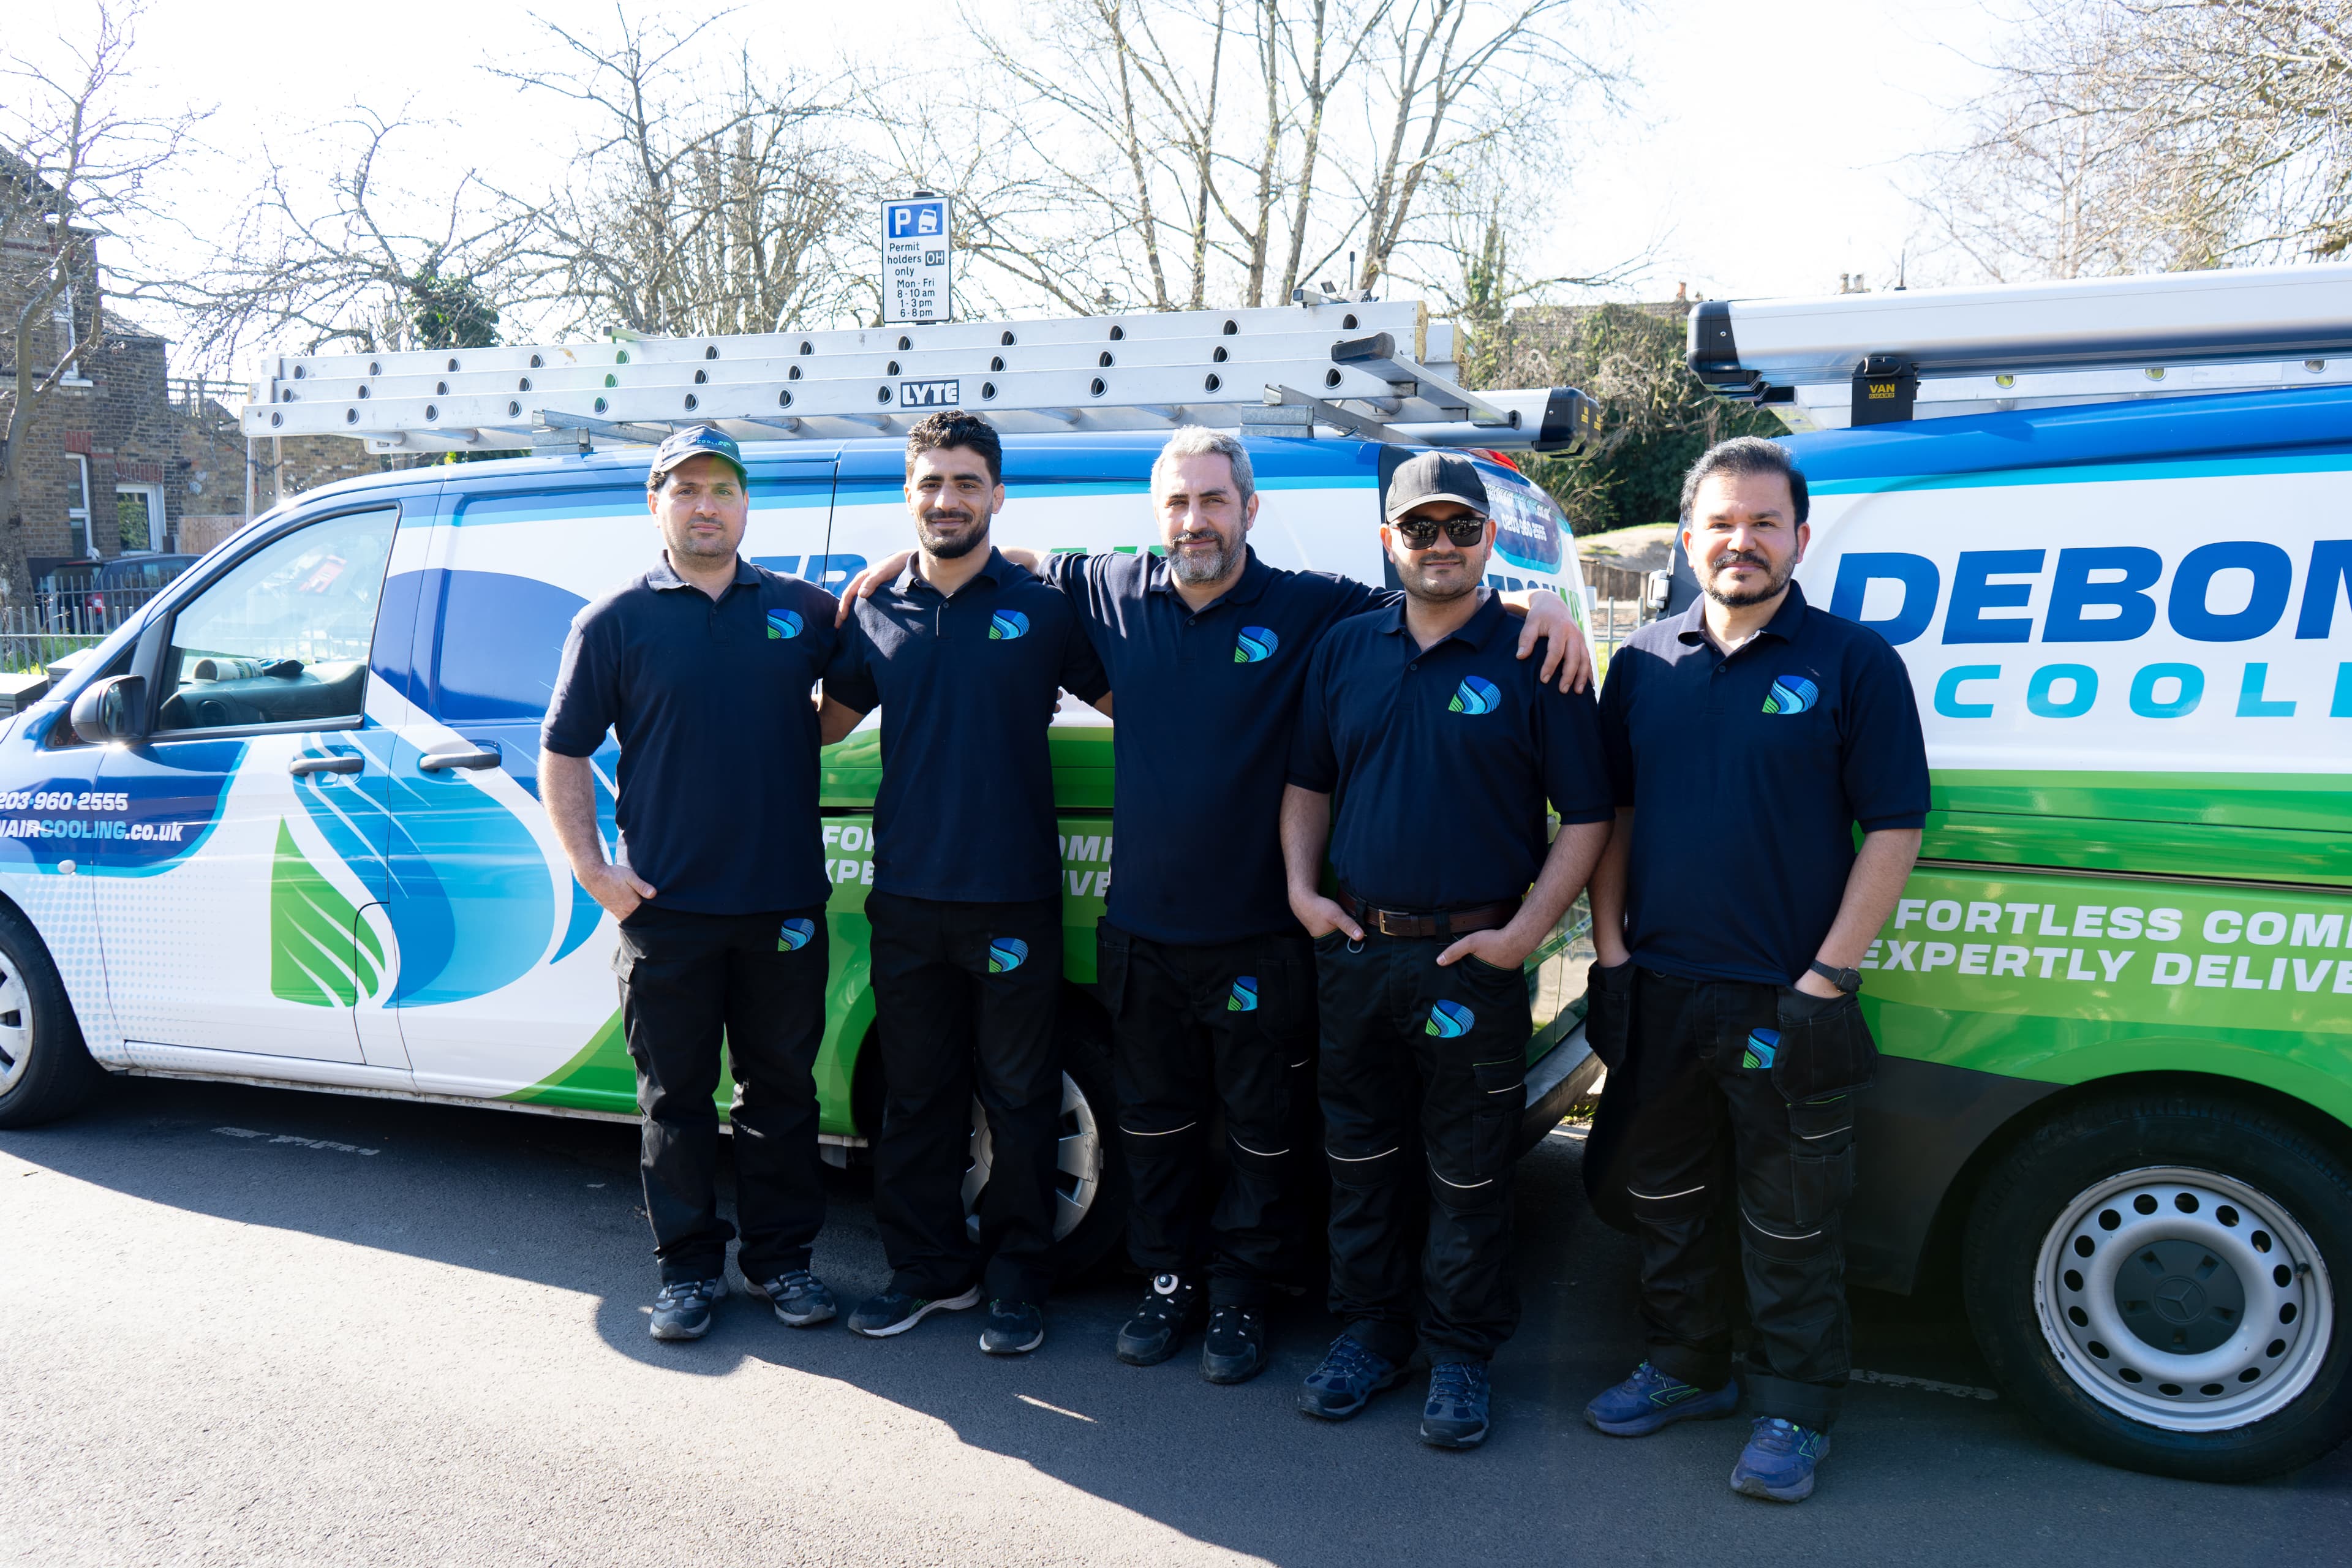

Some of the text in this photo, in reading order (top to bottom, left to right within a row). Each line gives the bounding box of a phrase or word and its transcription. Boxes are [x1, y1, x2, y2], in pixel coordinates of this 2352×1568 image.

[895, 208, 911, 235] P
[889, 241, 919, 252] Permit
[888, 255, 922, 264] holders
[927, 252, 943, 264] OH
[895, 266, 914, 277] only
[897, 279, 916, 288] Mon
[923, 277, 935, 287] Fri
[919, 300, 932, 308] pm
[902, 382, 957, 405] LYTE
[1869, 384, 1895, 393] VAN
[1894, 899, 2352, 948] FORTLESS COM
